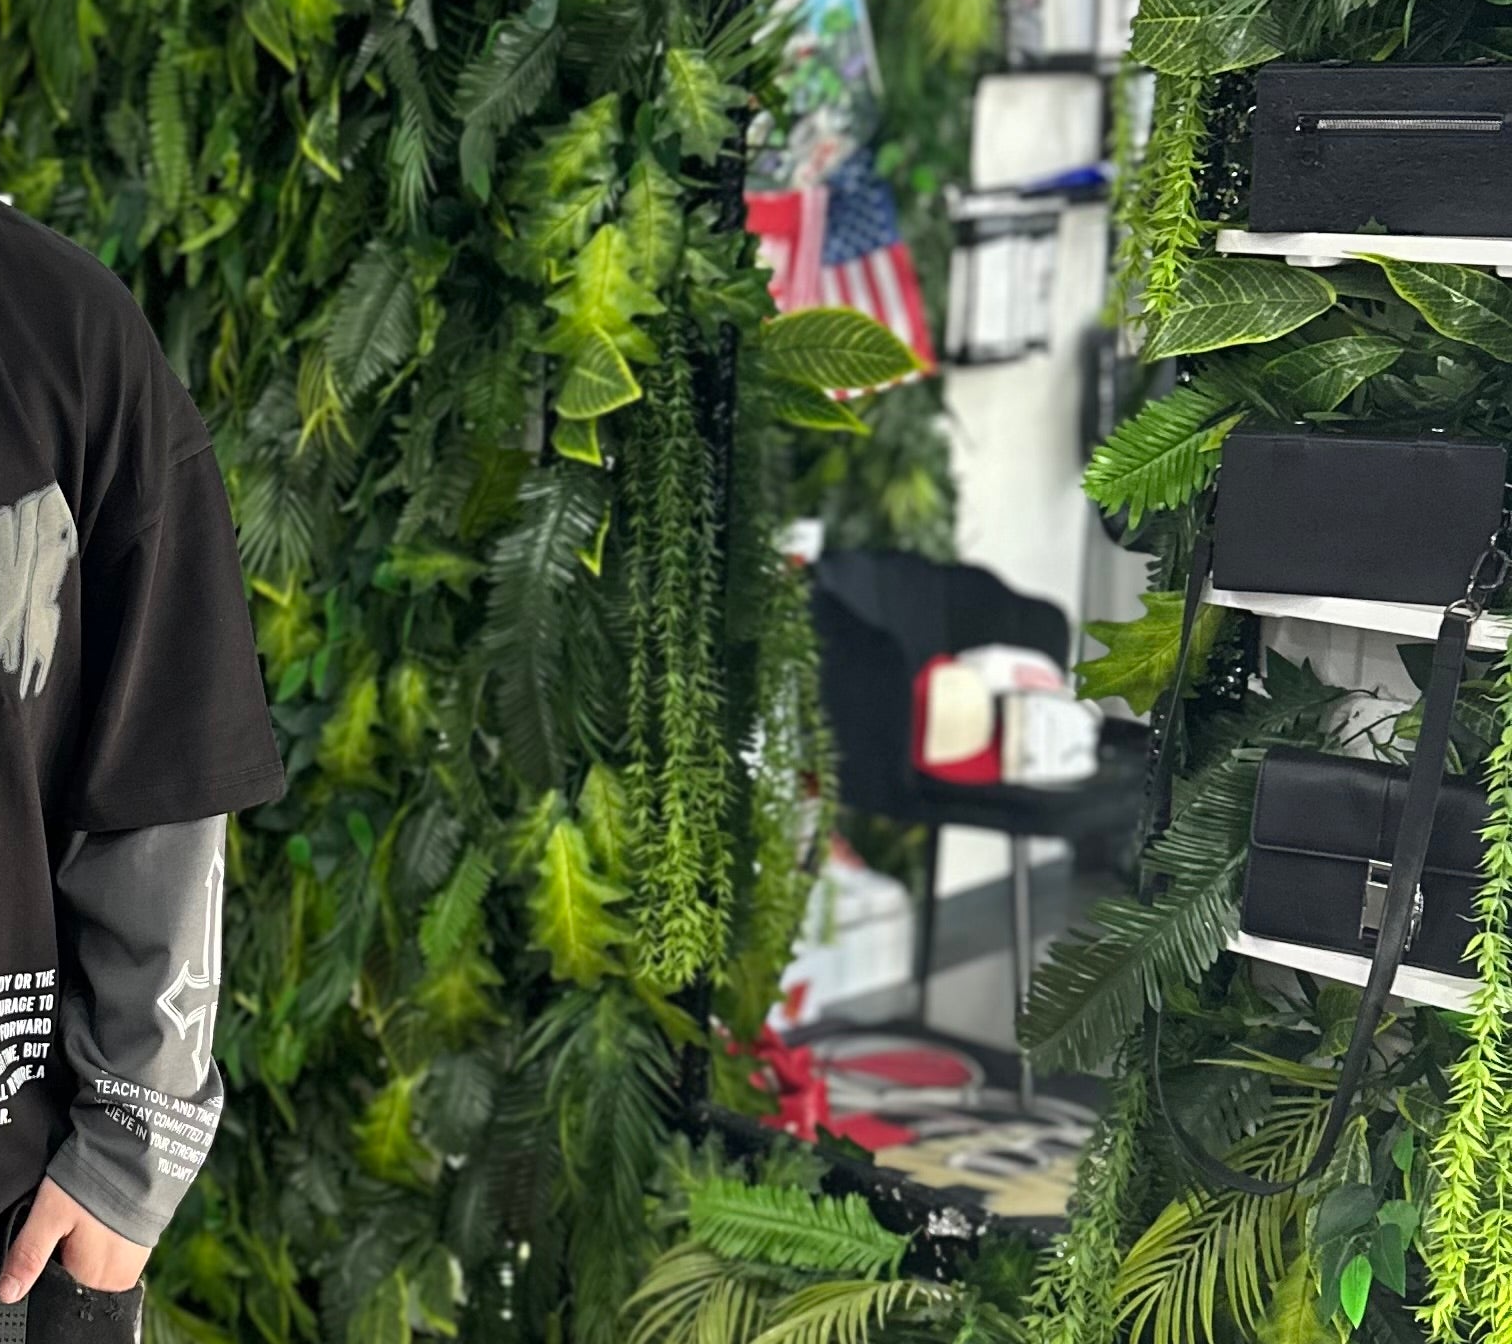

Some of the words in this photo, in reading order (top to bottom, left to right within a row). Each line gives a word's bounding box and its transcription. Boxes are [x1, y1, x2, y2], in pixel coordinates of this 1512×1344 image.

[14, 973, 32, 990] OR
[35, 969, 55, 988] THE
[39, 994, 54, 1011] TO
[0, 1017, 52, 1042] FORWARD
[23, 1041, 50, 1059] BUT
[95, 1079, 140, 1098] TEACH
[143, 1088, 169, 1109] YOU,
[172, 1099, 196, 1118] AND
[105, 1104, 136, 1132] LIEVE
[135, 1124, 148, 1141] IN
[150, 1131, 170, 1151] YOUR
[153, 1112, 204, 1143] COMMITTED
[158, 1157, 172, 1175] YOU
